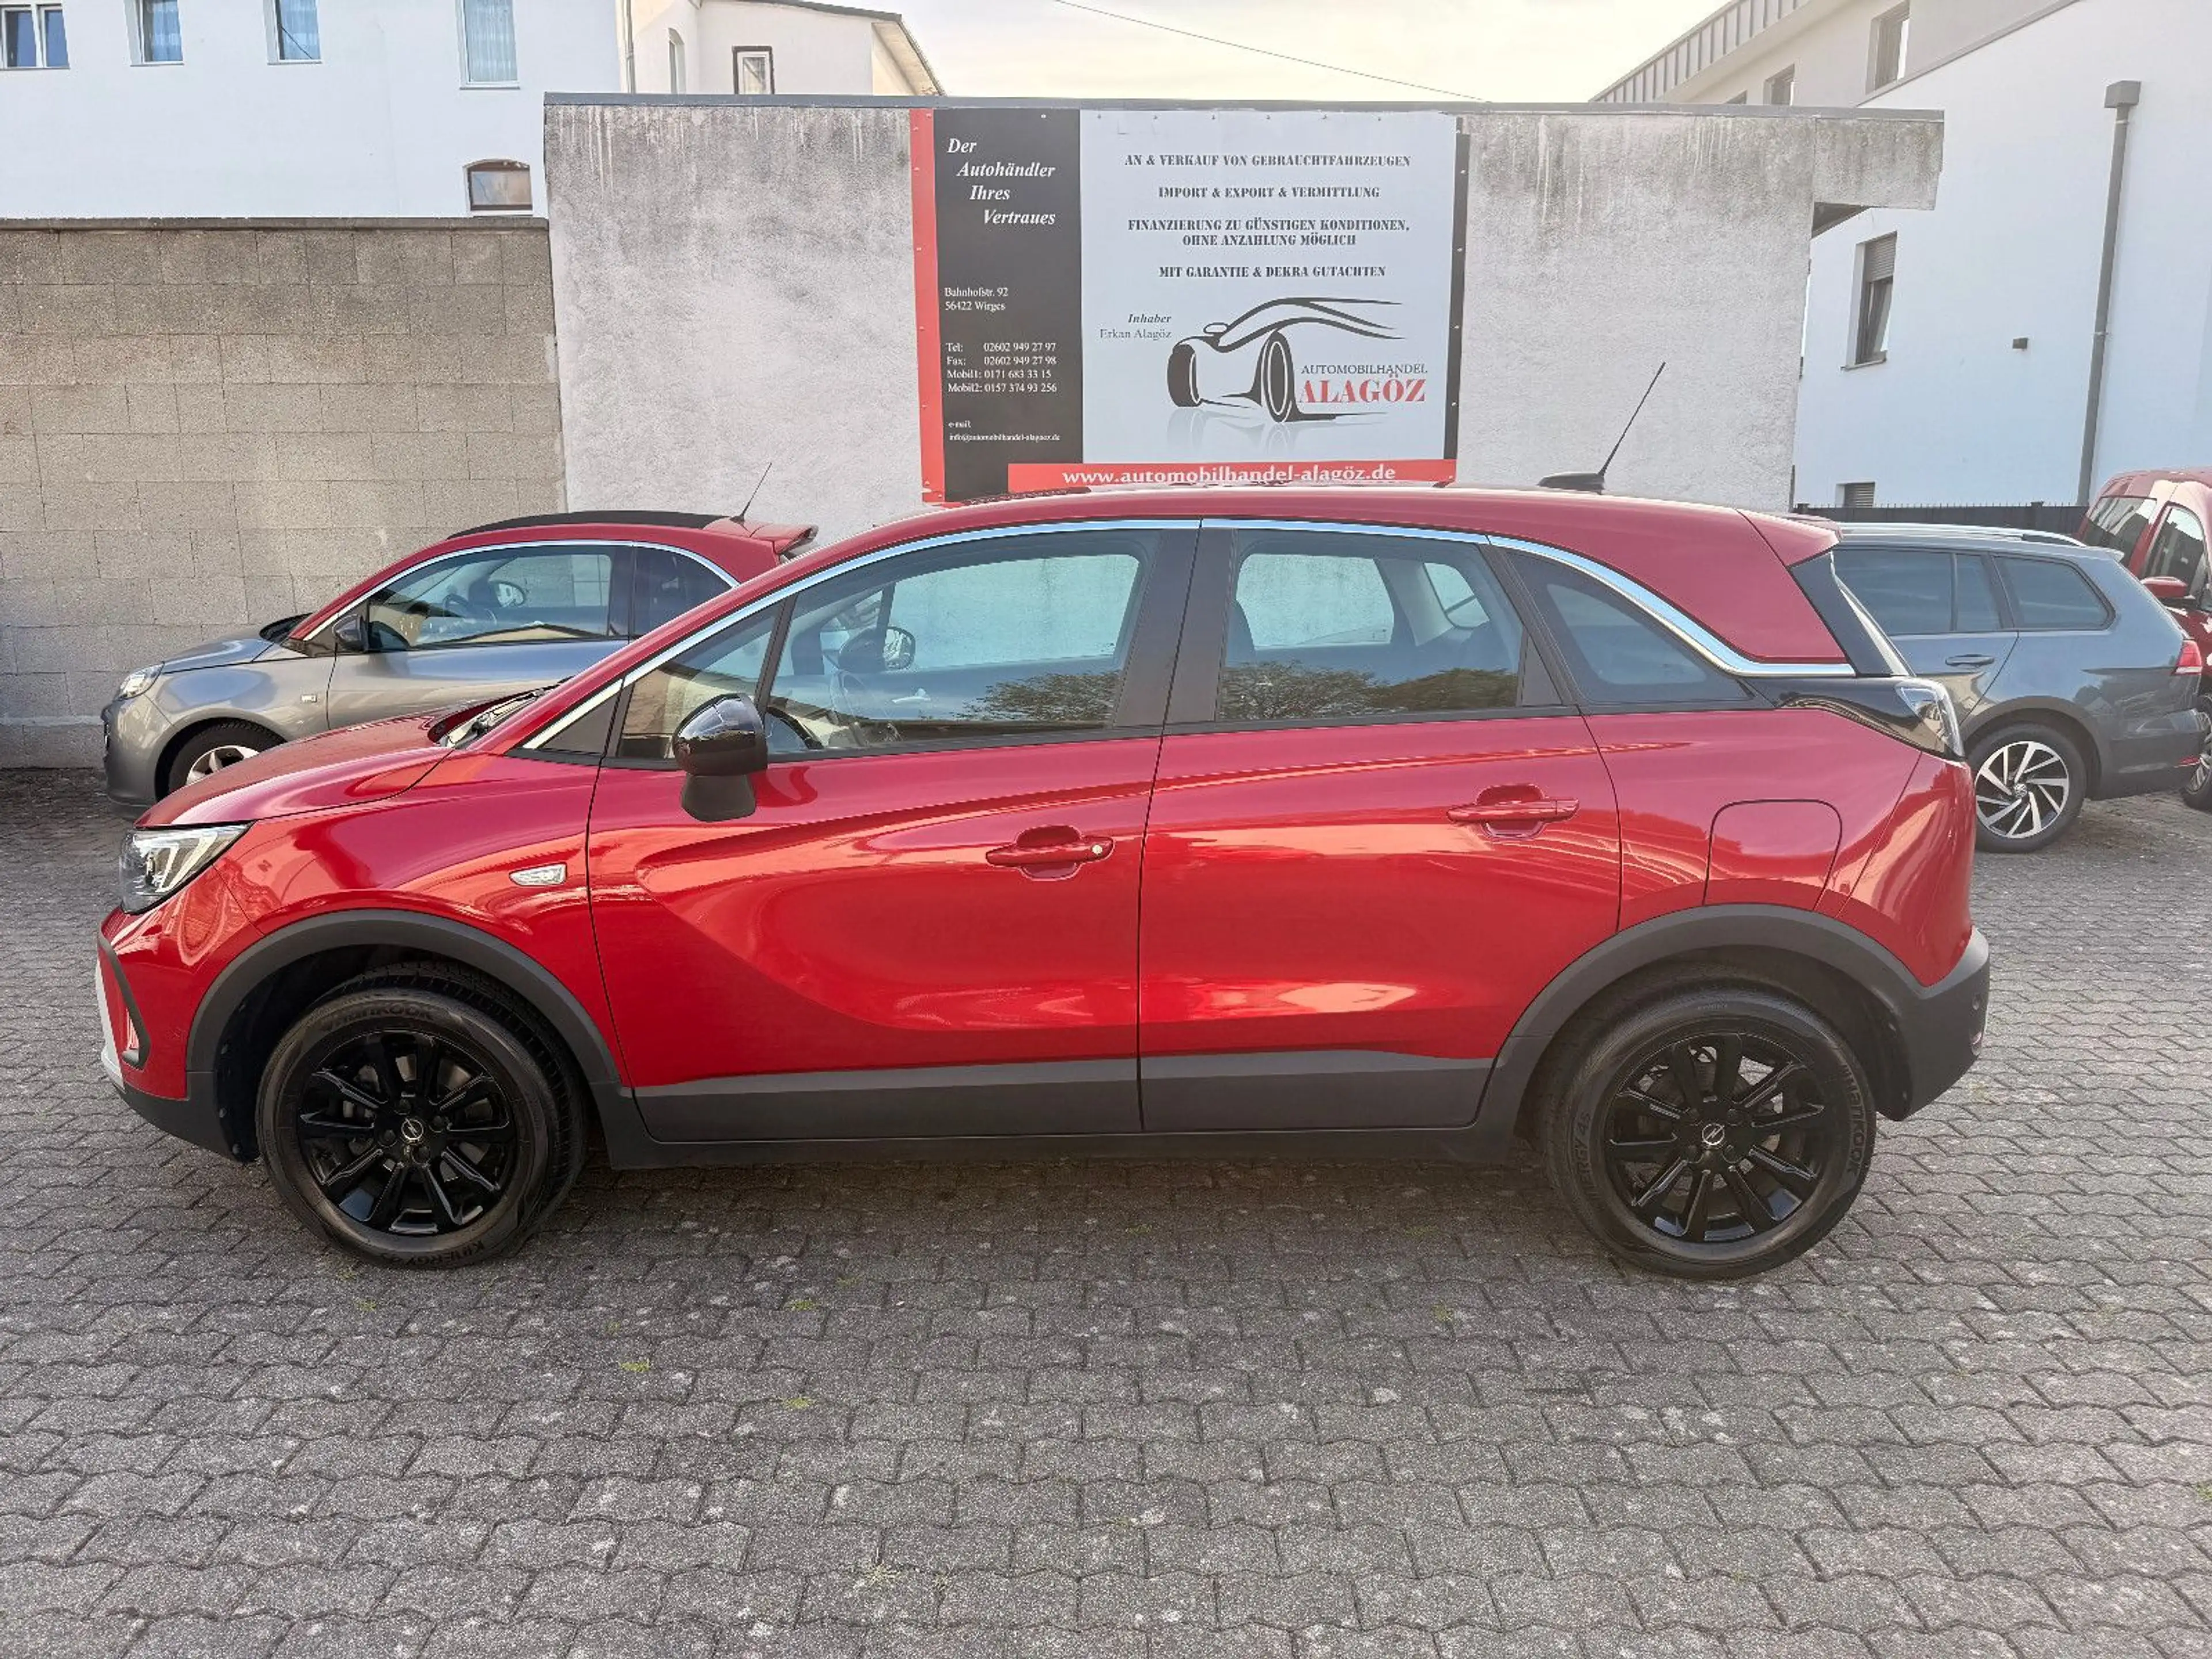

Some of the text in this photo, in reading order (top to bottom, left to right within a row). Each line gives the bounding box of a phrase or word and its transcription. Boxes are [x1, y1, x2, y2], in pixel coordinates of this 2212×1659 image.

[947, 138, 977, 153] Der
[1124, 154, 1411, 166] AN & VERKAUF VON GEBRAUCHTFAHRZEUGEN
[956, 161, 1056, 177] Autohändler
[969, 185, 1010, 200] Ihres
[1158, 187, 1380, 198] IMPORT & EXPORT & VERMITTLUNG
[983, 210, 1056, 225] Vertraues
[1128, 217, 1410, 232] FINANZIERUNG ZU GÜNSTIGEN KONDITIONEN,
[1183, 232, 1356, 245] OHNE ANZAHLUNG MÖGLICH
[1159, 266, 1386, 278] MIT GARANTIE & DEKRA GUTACHTEN
[944, 287, 1009, 297] Bahnhofstr. 92
[945, 301, 1005, 313] 56422 Wirges
[1128, 314, 1172, 323] Inhaber
[1100, 328, 1172, 341] Erkan Alagöz
[946, 343, 1056, 353] Tel: 02602 949 27 97
[946, 356, 1057, 366] Fax: 02602 949 27 98
[946, 369, 1052, 379] Mobil1: 0171 683 33 15
[1301, 364, 1427, 374] AUTOMOBILHANDEL
[948, 382, 1057, 392] Mobil2: 0157 374 93 256
[1299, 373, 1426, 404] ALAGÖZ
[1062, 464, 1396, 484] www.automobilhandel-alagöz.de
